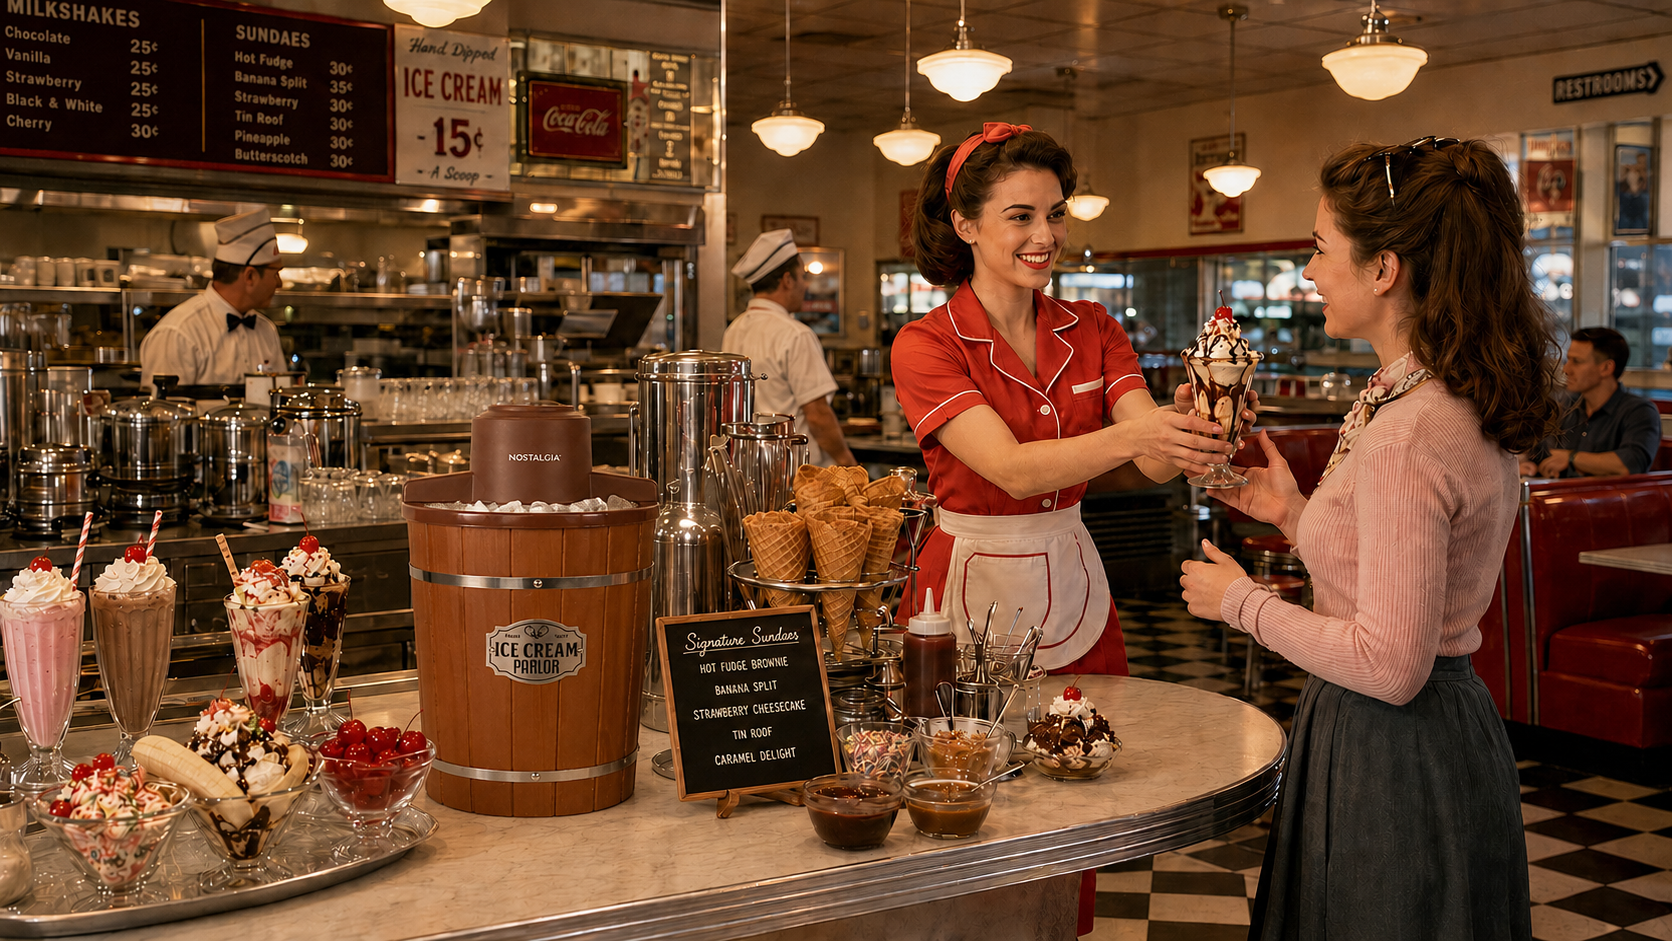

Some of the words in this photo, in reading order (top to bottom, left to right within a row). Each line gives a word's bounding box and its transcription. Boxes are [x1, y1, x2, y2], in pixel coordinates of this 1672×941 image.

[7, 0, 140, 28] MILKSHAKES
[5, 25, 71, 45] Chocolate
[235, 24, 311, 48] SUNDAES
[130, 39, 158, 54] 25¢
[409, 37, 448, 56] Hand
[451, 41, 498, 64] Dipped
[5, 47, 51, 64] Vanilla
[234, 51, 256, 64] Hot
[259, 53, 294, 70] Fudge
[130, 60, 158, 76] 25¢
[329, 61, 353, 76] 30¢
[6, 70, 82, 92] Strawberry
[234, 70, 277, 86] Banana
[280, 75, 308, 90] Split
[329, 80, 353, 94] 35¢
[404, 66, 435, 99] ICE
[441, 71, 502, 106] CREAM
[1555, 68, 1647, 101] RESTROOMS
[131, 81, 159, 97] 25¢
[6, 93, 43, 108] Black
[49, 97, 59, 109] &
[65, 98, 103, 113] White
[234, 90, 299, 110] Strawberry
[329, 98, 353, 113] 30¢
[131, 103, 159, 118] 25¢
[234, 110, 253, 123] Tin
[257, 112, 284, 126] Roof
[6, 114, 52, 132] Cherry
[131, 123, 159, 138] 30¢
[329, 117, 353, 131] 30¢
[234, 130, 291, 147] Pineapple
[329, 135, 353, 150] 30¢
[433, 116, 484, 158] 15¢
[234, 148, 309, 165] Butterscotch
[329, 154, 353, 169] 30¢
[430, 165, 440, 179] A
[444, 166, 480, 185] Scoop
[508, 454, 561, 462] NOSTALGIA
[495, 642, 519, 657] ICE
[523, 642, 578, 658] CREAM
[685, 632, 746, 657] Signature
[751, 626, 800, 644] Sundaes
[513, 659, 560, 674] PARLOR
[700, 662, 717, 674] HOT
[720, 660, 748, 672] FUDGE
[751, 656, 789, 670] BROWNIE
[714, 683, 750, 696] BANANA
[752, 680, 778, 692] SPLIT
[693, 705, 749, 721] STRAWBERRY
[752, 699, 807, 715] CHEESECAKE
[732, 729, 747, 740] TIN
[750, 726, 773, 738] ROOF
[714, 752, 756, 766] CARAMEL
[759, 747, 797, 762] DELIGHT
